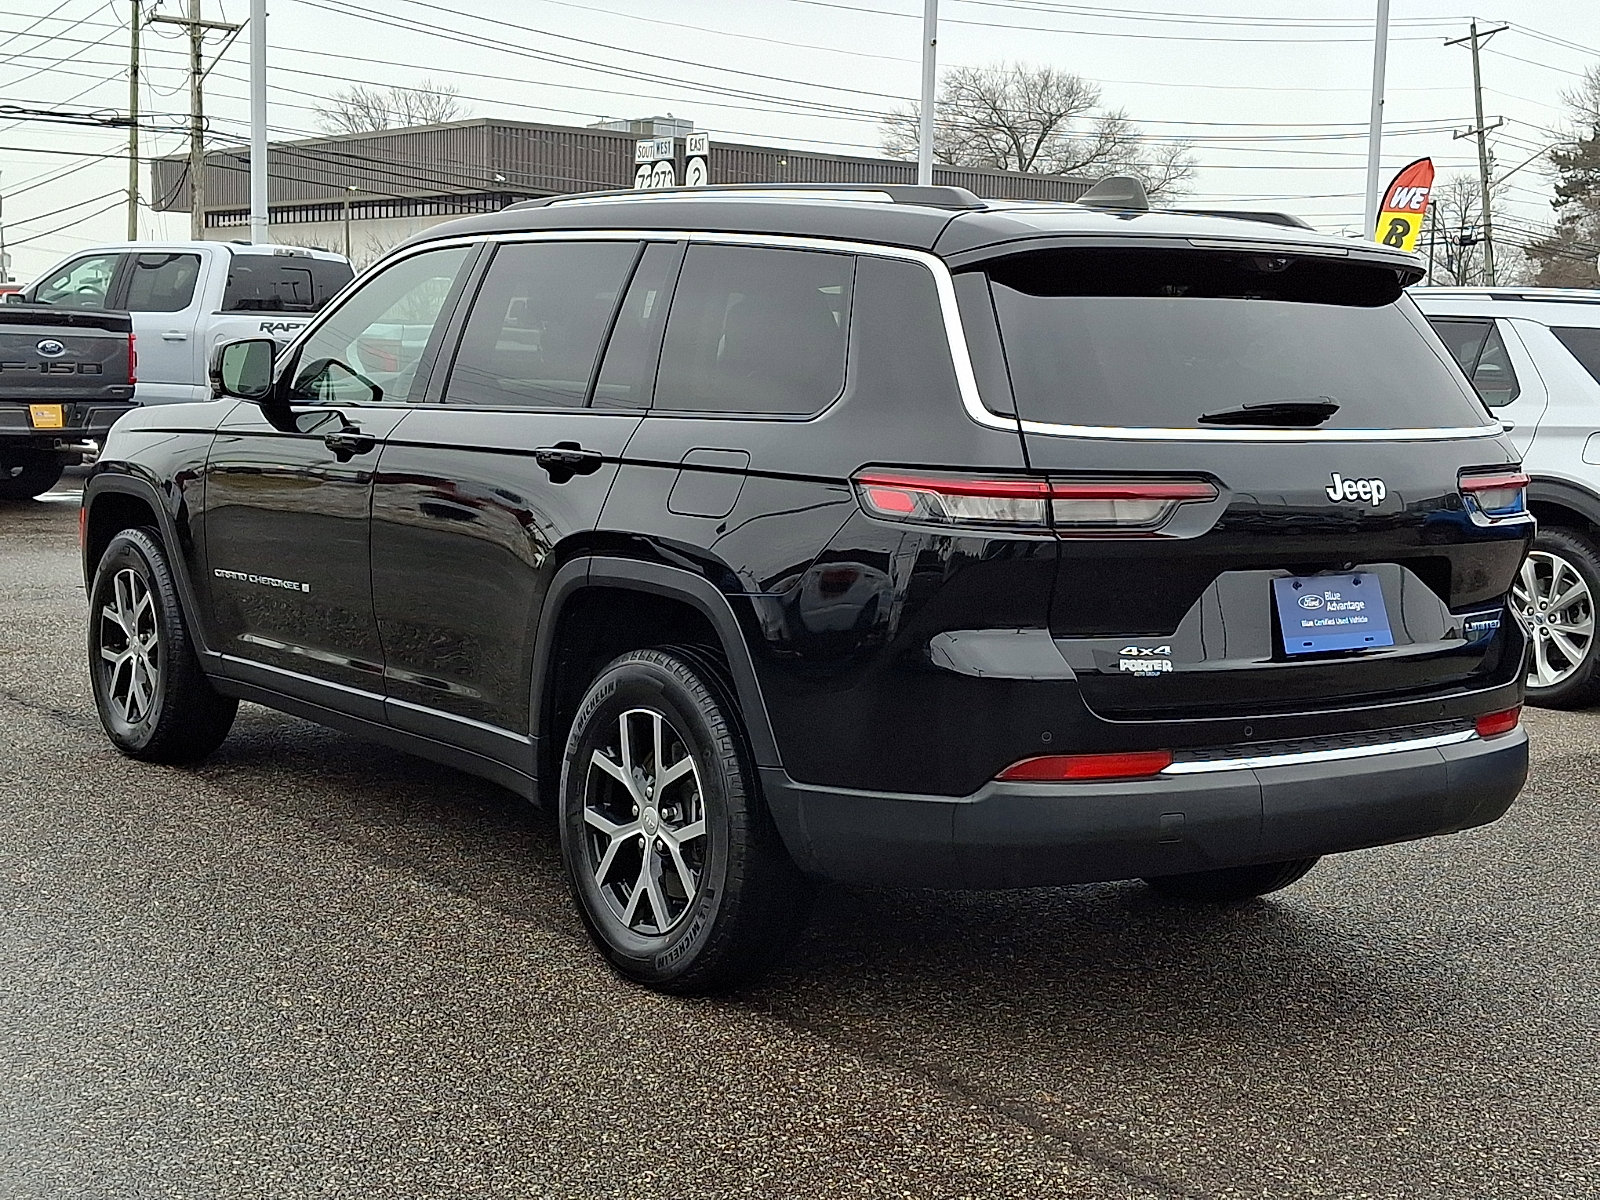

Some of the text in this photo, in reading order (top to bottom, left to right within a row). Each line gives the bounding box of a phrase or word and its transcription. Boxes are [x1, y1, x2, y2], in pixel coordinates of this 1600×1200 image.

[656, 141, 671, 155] WEST
[689, 138, 705, 151] EAST
[1389, 186, 1429, 209] WE
[1382, 217, 1411, 248] B
[0, 361, 103, 376] F-150
[1326, 472, 1386, 506] Jeep
[214, 568, 247, 581] GRAND
[248, 574, 301, 591] CHEROKEE
[1324, 591, 1341, 601] Blue
[1326, 600, 1366, 612] Advantage
[1314, 617, 1336, 626] Certified
[1335, 616, 1350, 625] Used
[1349, 615, 1369, 624] Vehicle
[1119, 645, 1172, 656] 4x4
[1119, 658, 1173, 672] PORTER
[577, 680, 616, 733] MICHELIN
[657, 920, 701, 969] MICHELIN
